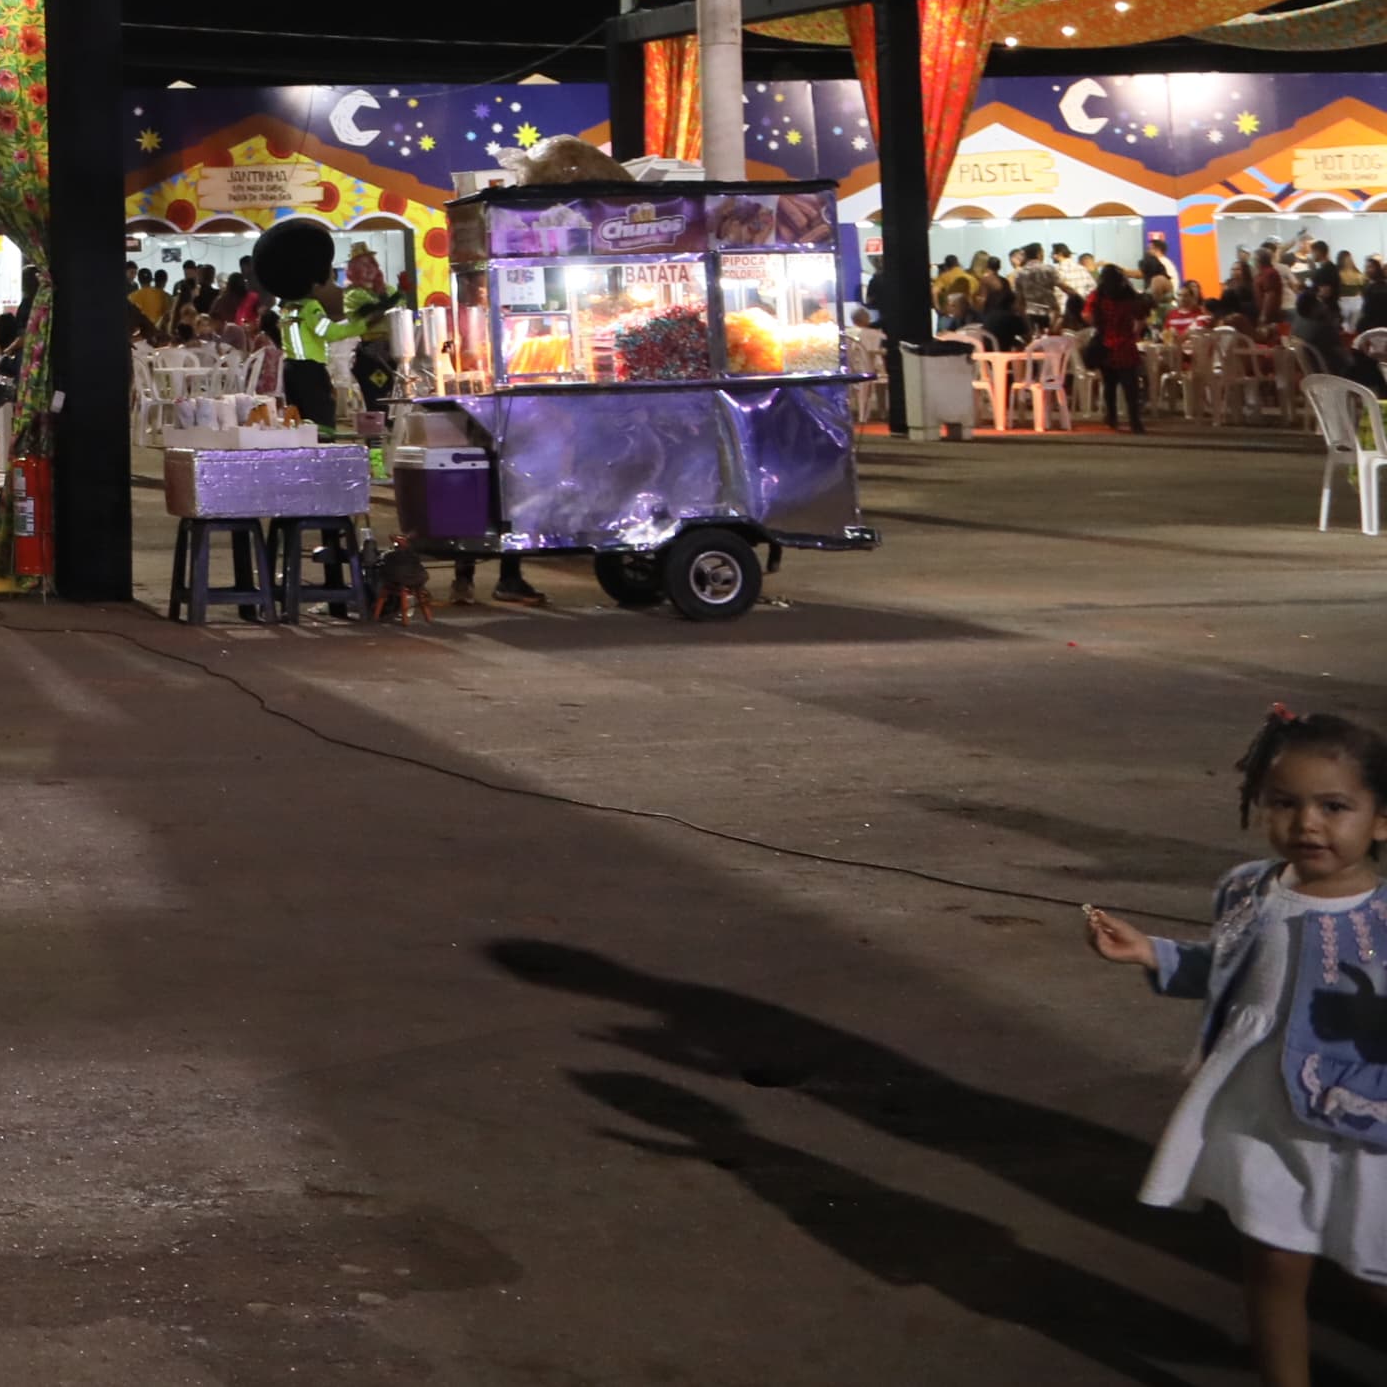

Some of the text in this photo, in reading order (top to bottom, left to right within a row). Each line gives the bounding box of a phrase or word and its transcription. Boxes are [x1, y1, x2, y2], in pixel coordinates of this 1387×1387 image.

[1314, 153, 1344, 171] HOT
[227, 170, 288, 183] JANTINHA
[959, 162, 1034, 183] PASTEL
[602, 217, 683, 240] Churros
[723, 256, 766, 266] PIPOCA
[626, 265, 691, 283] BATATA
